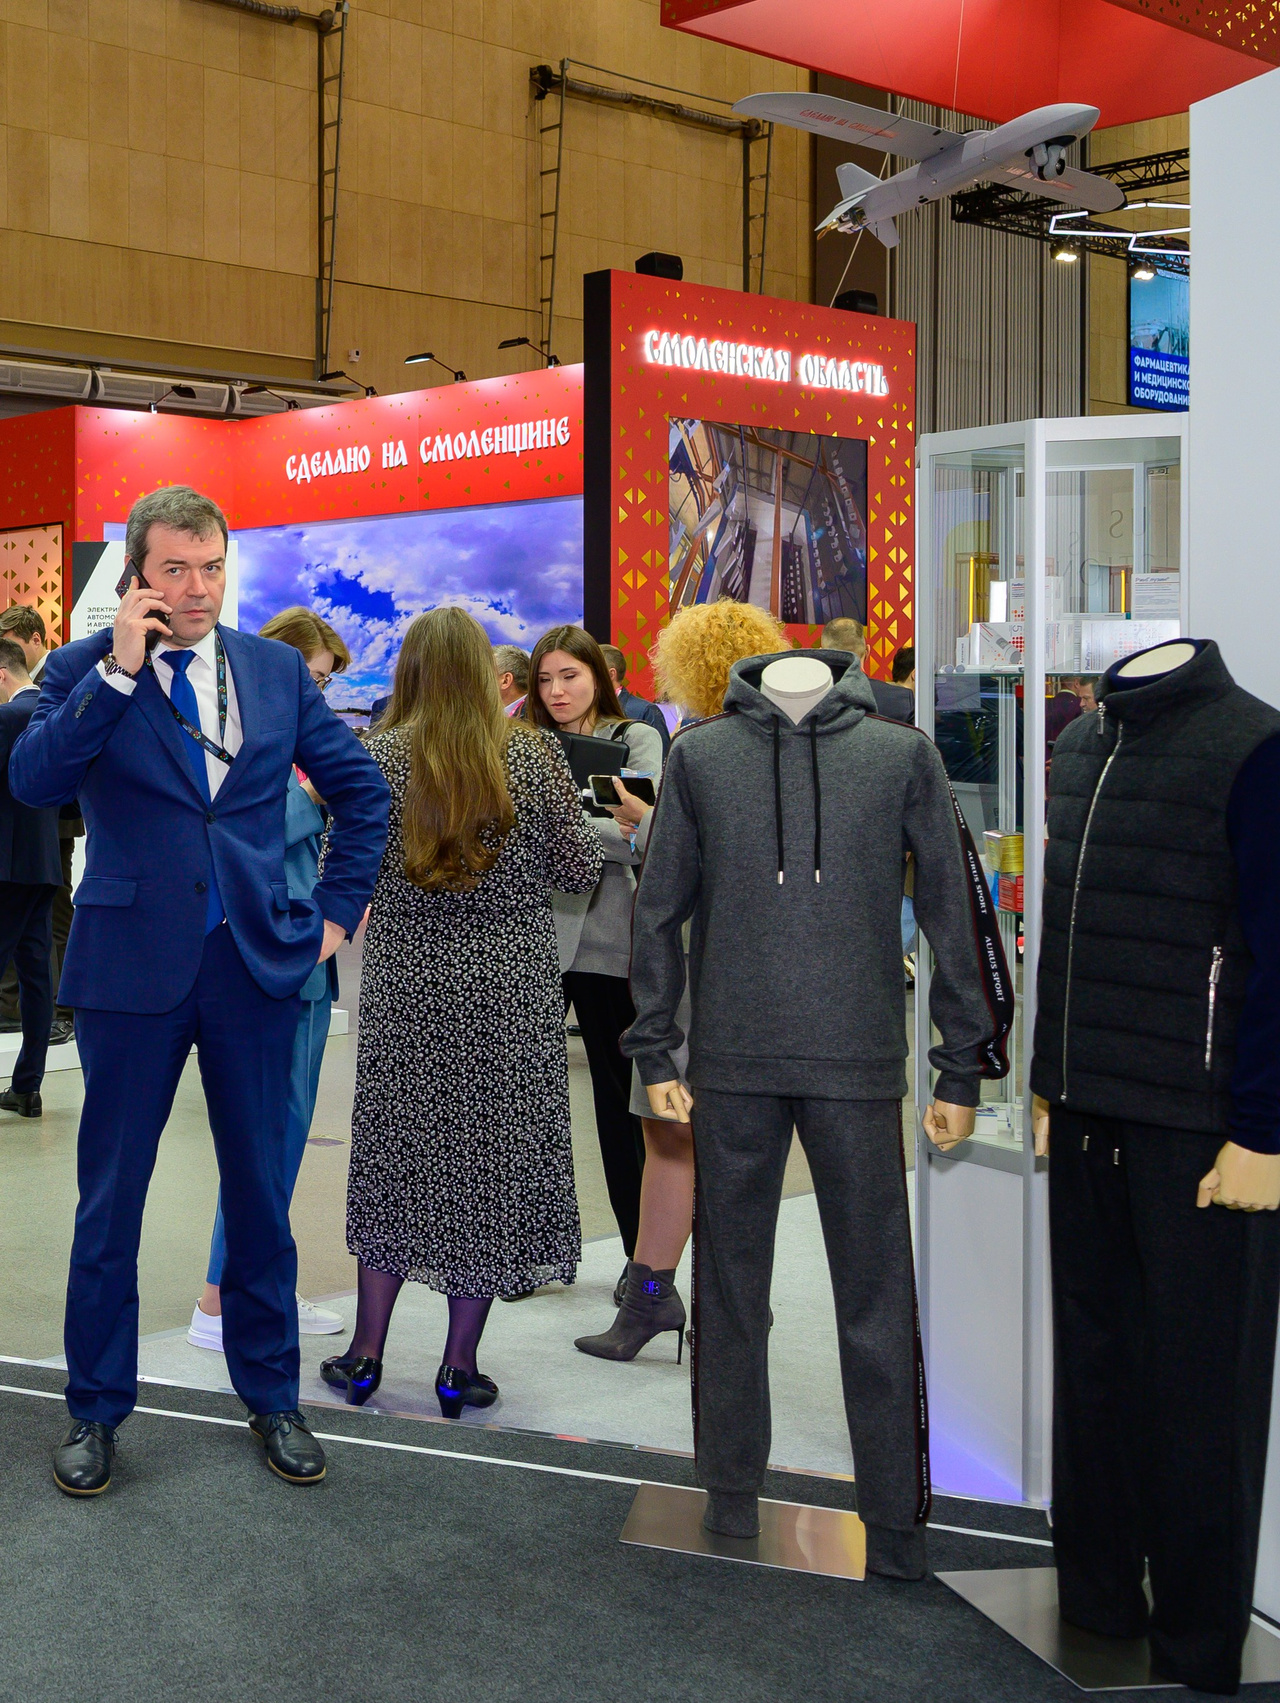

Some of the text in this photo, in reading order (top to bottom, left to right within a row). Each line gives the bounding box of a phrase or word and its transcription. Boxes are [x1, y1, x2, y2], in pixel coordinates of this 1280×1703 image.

[644, 330, 890, 397] СМОЛЕНСКАЯ ОБЛАСТЬ
[1134, 371, 1190, 391] И МЕДИЦИНСКО
[285, 416, 571, 485] СДЕЛАНО НА СМОЛЕНЩИНЕ
[967, 850, 988, 915] AURUS SPORT
[984, 935, 1005, 1002] AURUS SPORT
